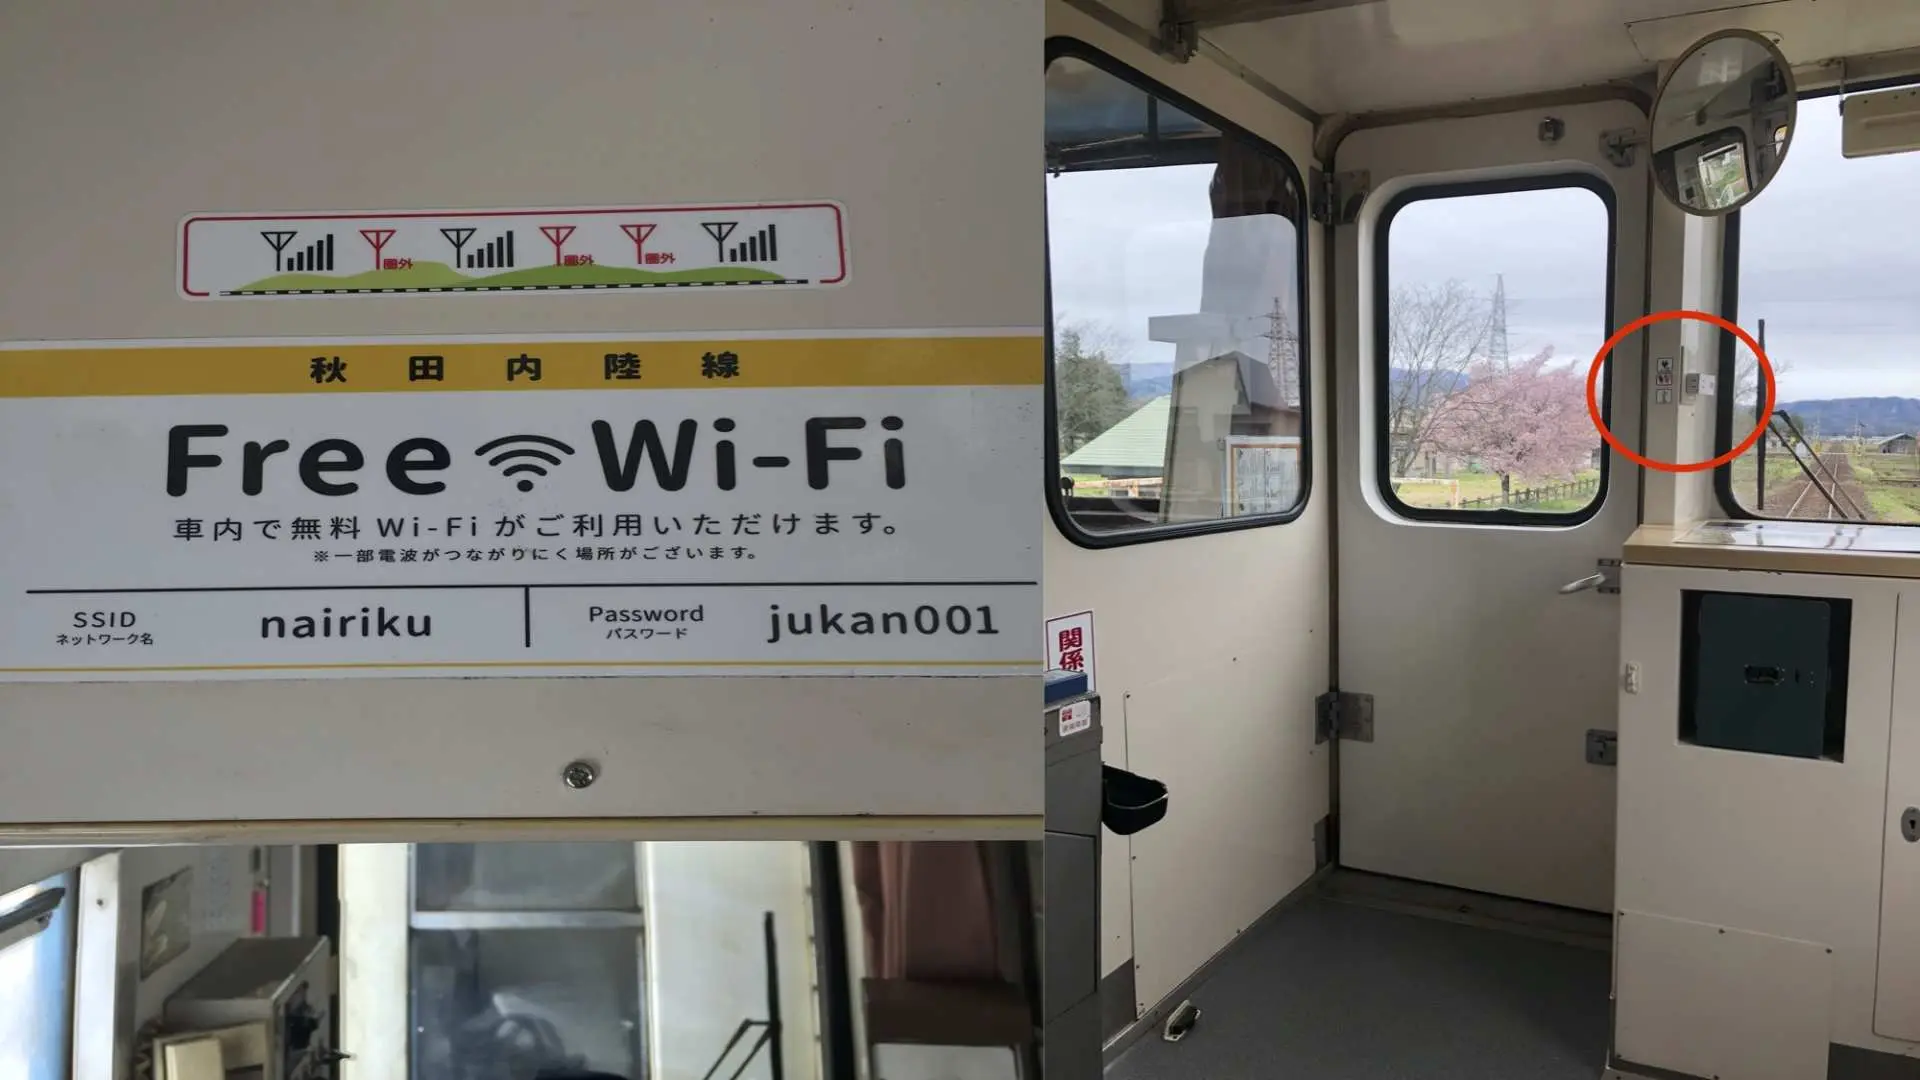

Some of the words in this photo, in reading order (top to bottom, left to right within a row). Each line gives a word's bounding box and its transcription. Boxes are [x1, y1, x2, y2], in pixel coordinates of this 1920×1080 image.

[309, 351, 741, 383] 秋田内陸線
[166, 424, 451, 497] Free
[591, 415, 906, 492] Wi-Fi
[173, 516, 361, 541] 車内で無料
[376, 516, 477, 537] Wi-Fi
[495, 513, 896, 538] がご利用いただけます。
[73, 611, 136, 628] SSID
[261, 606, 432, 638] nairiku
[589, 604, 704, 622] Password
[767, 604, 1000, 644] jukan001
[55, 633, 154, 646] ネットワーク名
[606, 627, 688, 640] パスワード
[1058, 627, 1084, 672] 関係
